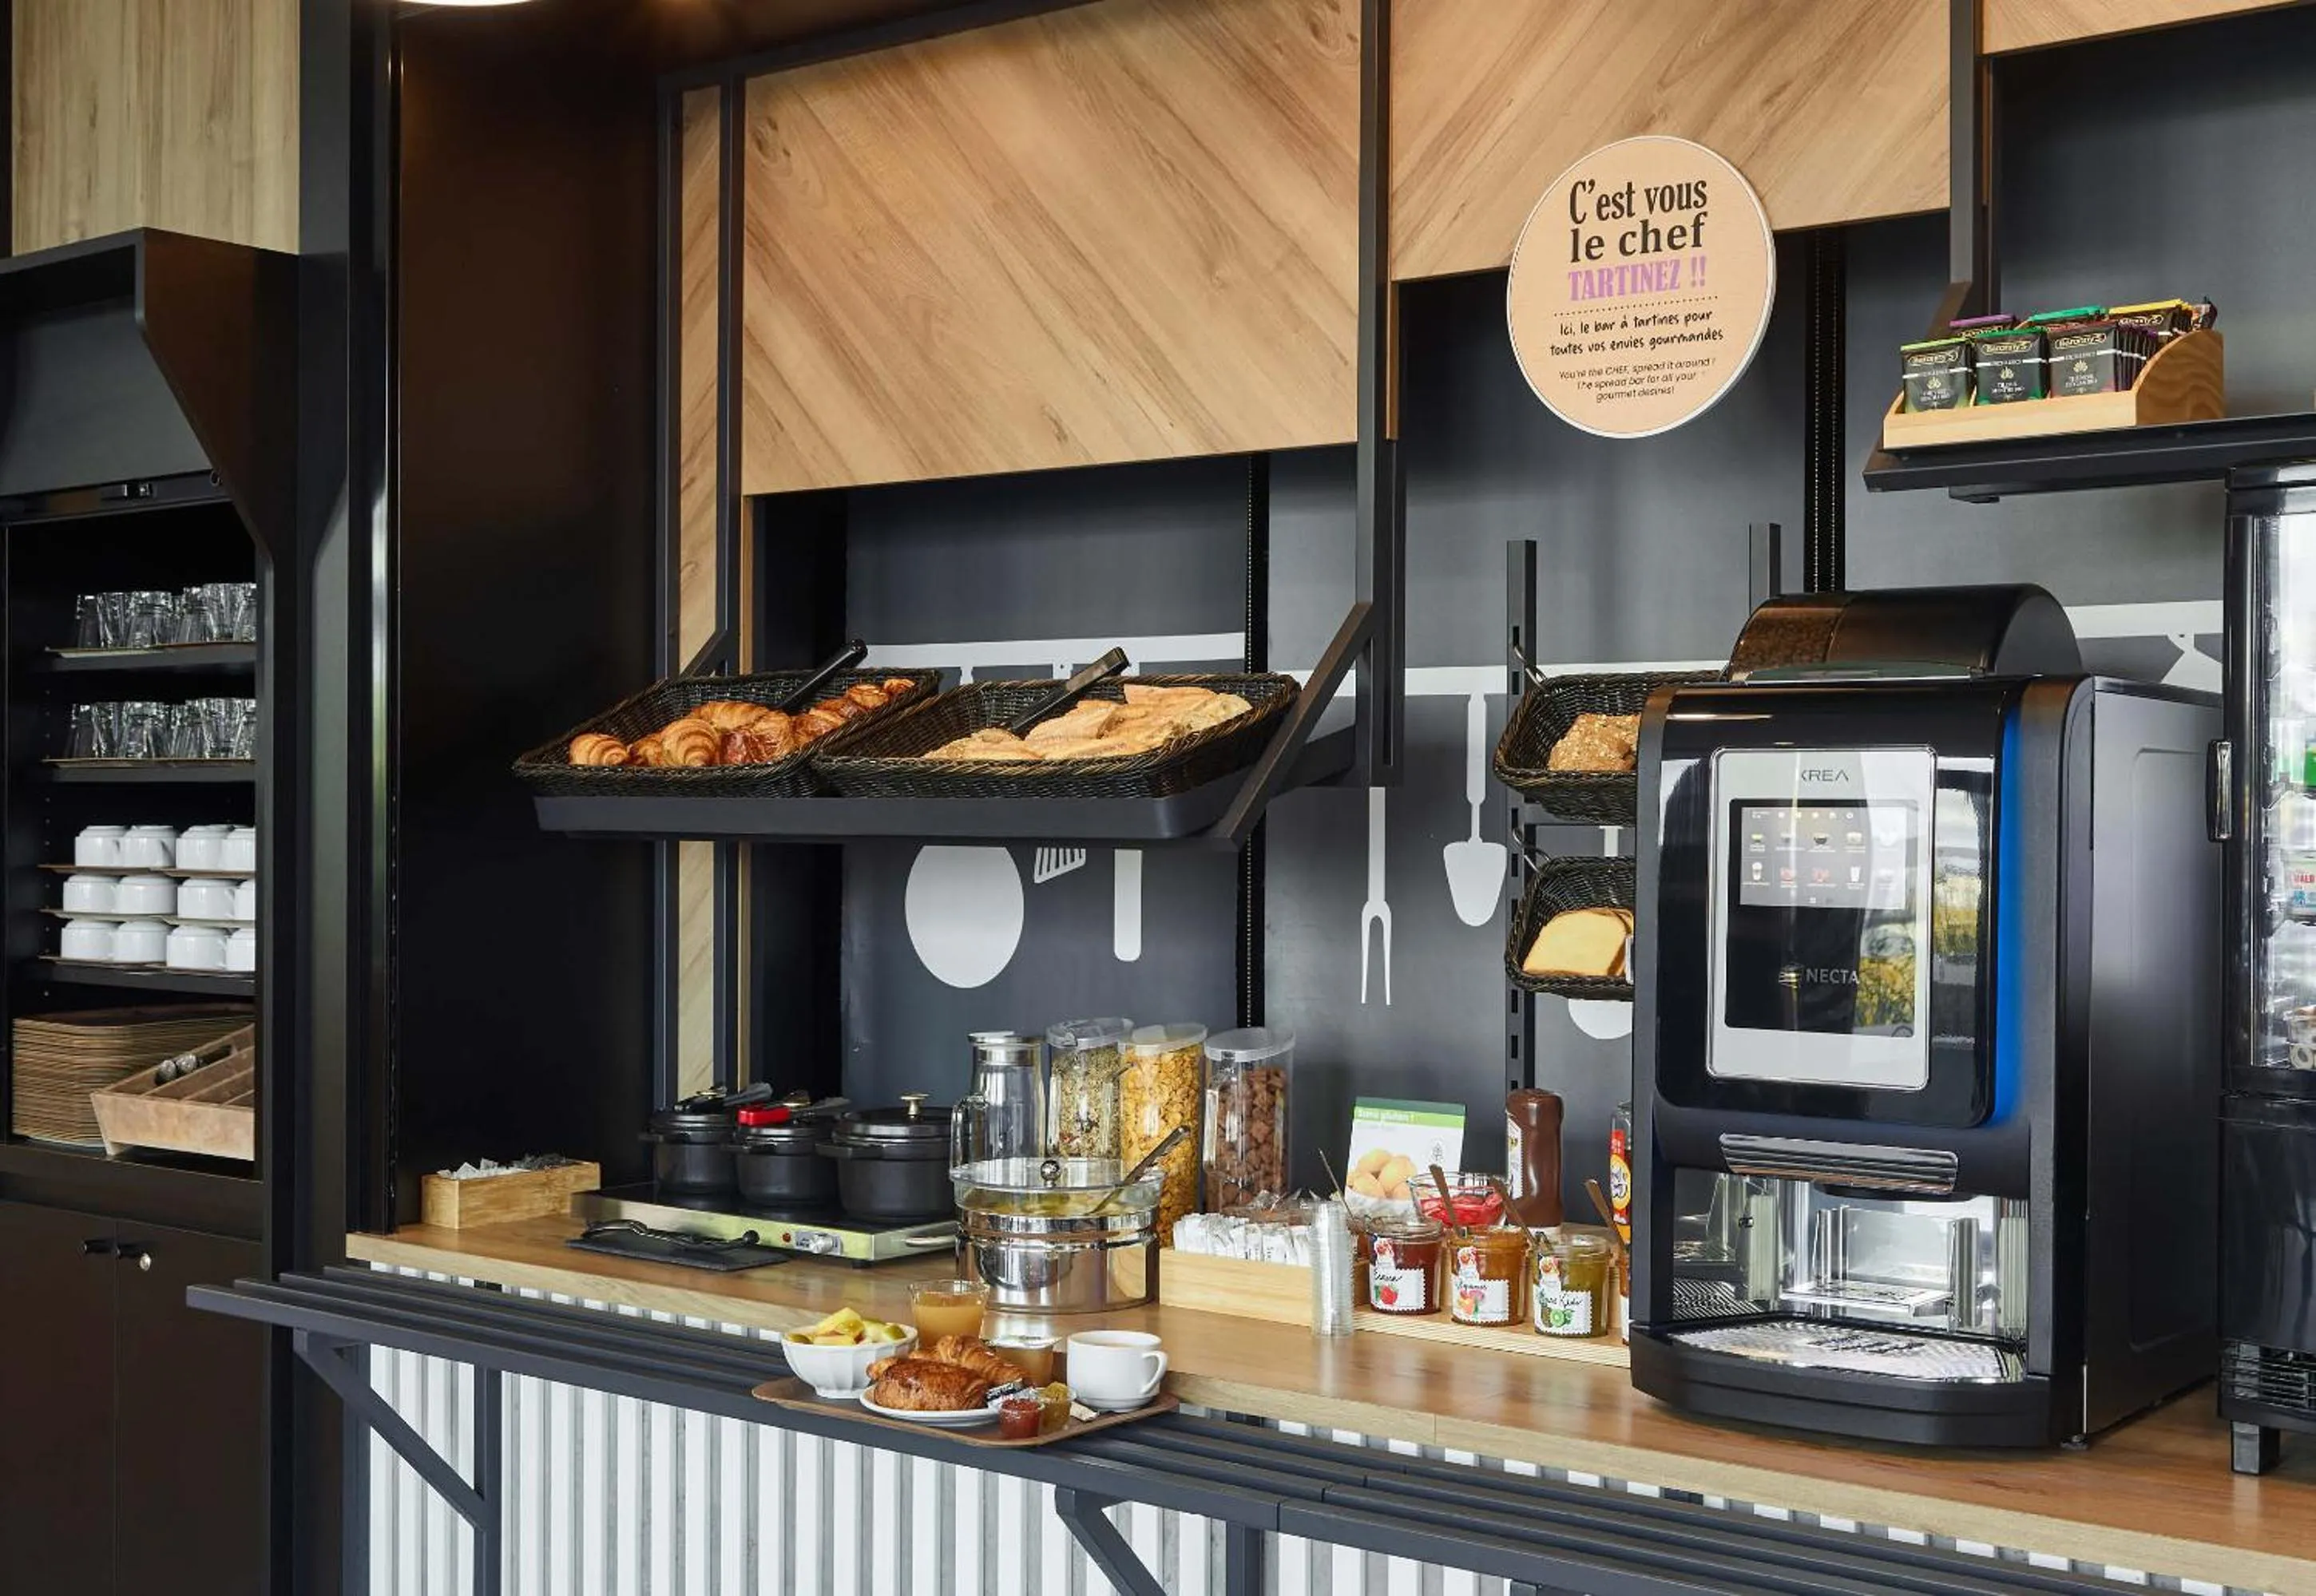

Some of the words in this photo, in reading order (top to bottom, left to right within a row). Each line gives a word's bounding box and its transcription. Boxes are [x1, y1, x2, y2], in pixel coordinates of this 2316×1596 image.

[1644, 180, 1707, 215] vous
[1570, 228, 1605, 263] le
[1619, 211, 1708, 256] chef
[1568, 259, 1681, 301] TARTINEZ
[1691, 255, 1707, 287] !!
[1560, 323, 1576, 336] Ici,
[1580, 321, 1590, 334] le
[1594, 319, 1616, 332] bar
[1620, 315, 1628, 329] à
[1633, 312, 1679, 328] tartines
[1683, 311, 1713, 327] pour
[1550, 343, 1583, 356] toutes
[1588, 340, 1606, 353] vos
[1610, 335, 1644, 350] envies
[1648, 328, 1724, 350] gourmandes
[1628, 375, 1646, 386] bar
[1646, 374, 1660, 384] for
[1676, 371, 1697, 383] your
[1806, 968, 1860, 984] NECTA
